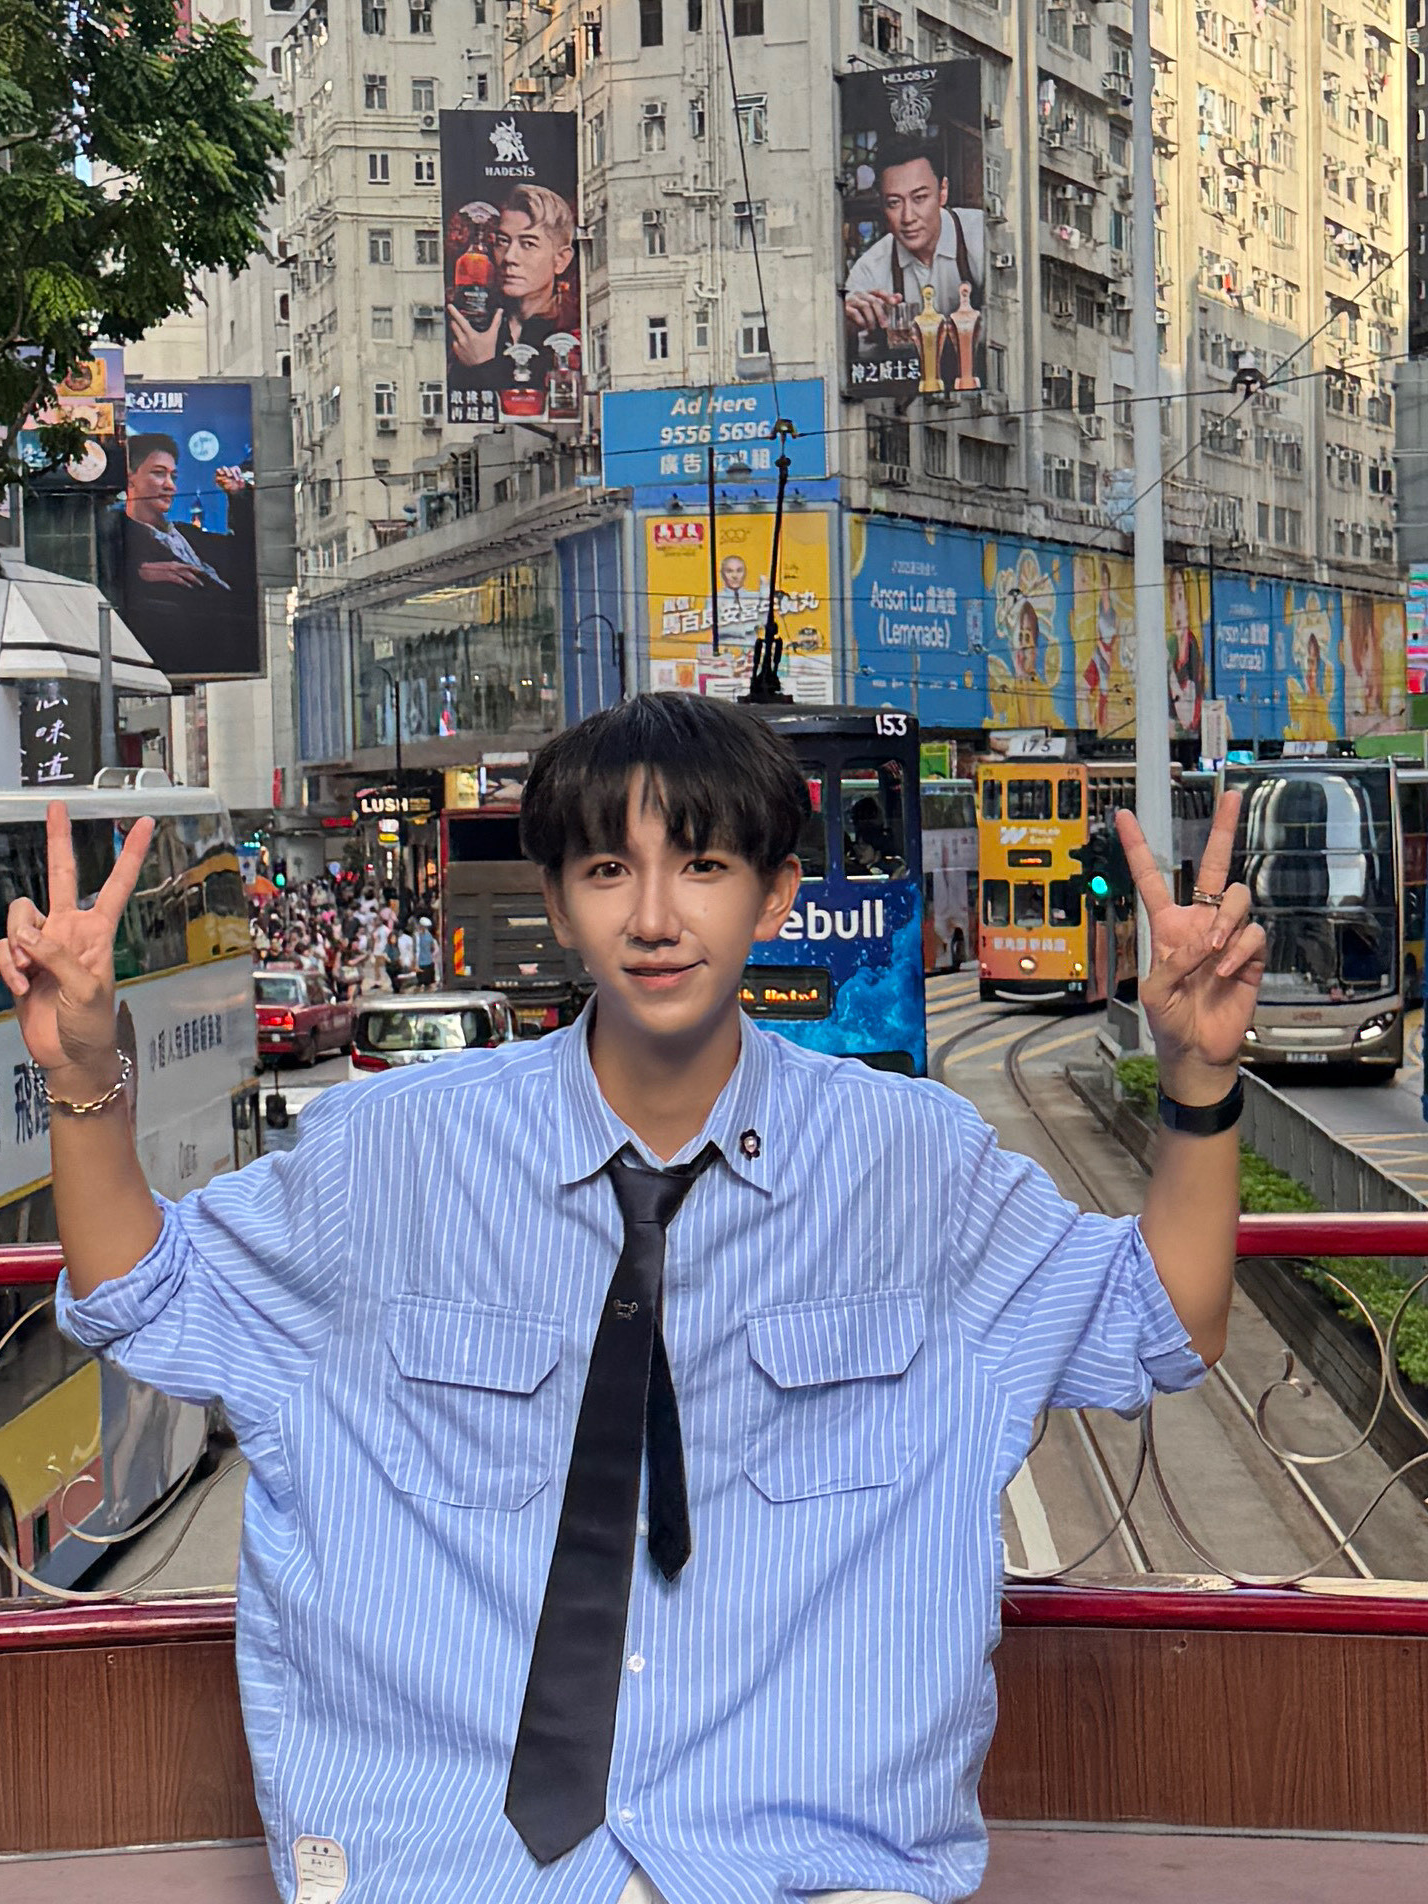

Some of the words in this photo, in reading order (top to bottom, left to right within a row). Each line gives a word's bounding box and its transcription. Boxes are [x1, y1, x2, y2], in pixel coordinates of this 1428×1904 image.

[670, 396, 703, 416] Ad
[707, 396, 758, 414] Here
[660, 425, 712, 446] 9556
[718, 420, 772, 442] 5696
[871, 581, 907, 611] Anson
[910, 585, 924, 613] Lo
[876, 713, 908, 737] 153
[361, 798, 409, 813] LUSH
[778, 899, 885, 940] ebull
